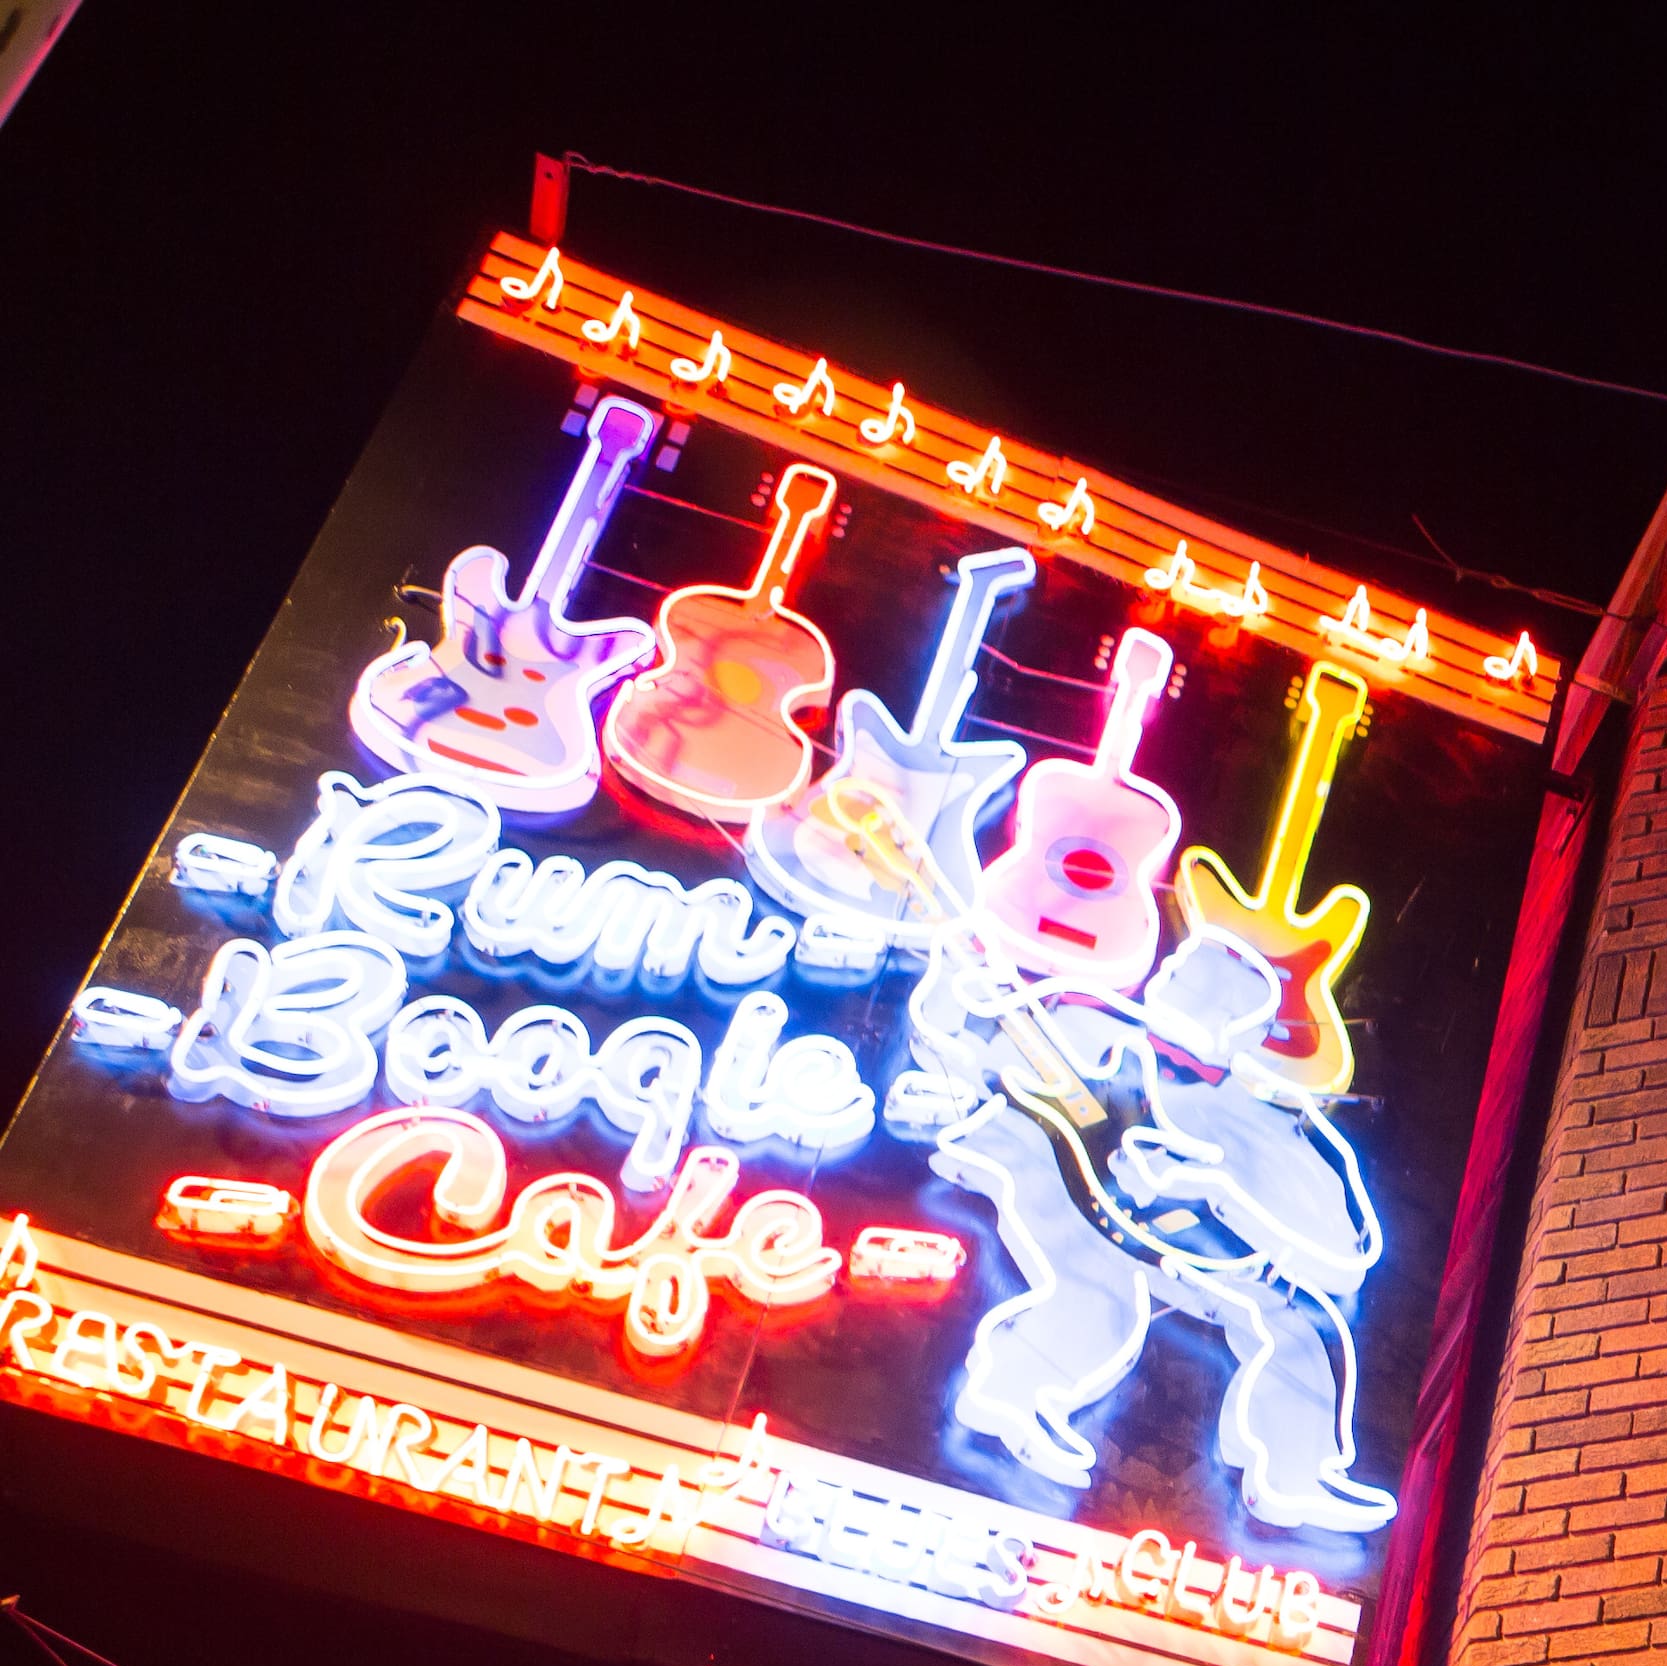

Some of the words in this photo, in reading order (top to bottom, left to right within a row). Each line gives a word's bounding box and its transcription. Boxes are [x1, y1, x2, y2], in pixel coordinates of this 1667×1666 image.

[272, 770, 798, 988] Rum
[166, 928, 878, 1193] Boogie
[304, 1104, 842, 1358] Cafe
[0, 1289, 630, 1540] RESTAURANT
[1118, 1527, 1324, 1652] CLUB
